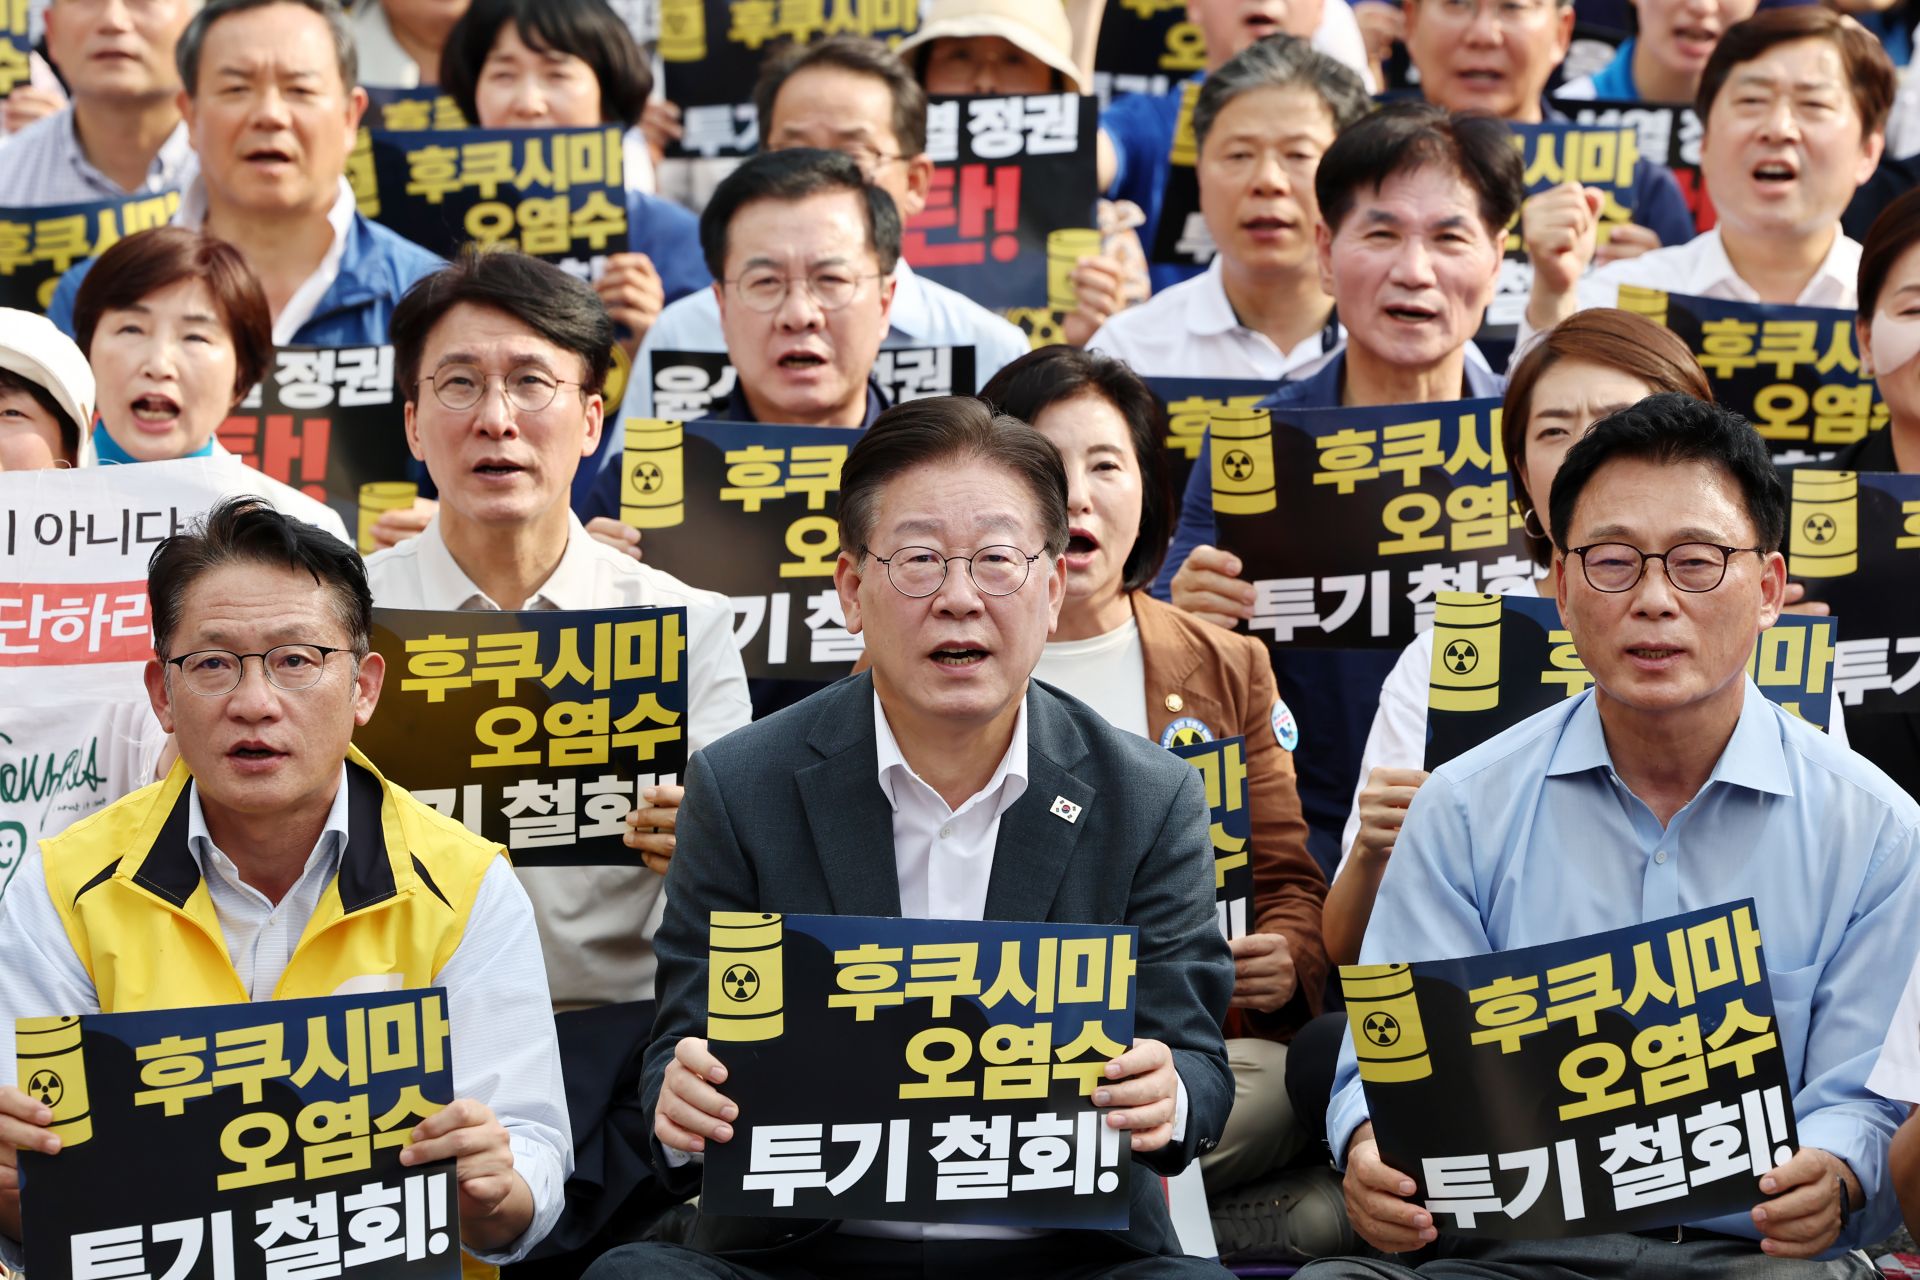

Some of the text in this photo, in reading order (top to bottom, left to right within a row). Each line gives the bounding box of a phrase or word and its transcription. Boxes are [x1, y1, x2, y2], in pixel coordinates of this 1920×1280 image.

[967, 92, 1080, 159] 정권
[1512, 128, 1640, 187] 시마
[405, 128, 624, 205] 후쿠시마
[463, 191, 628, 256] 오염수
[902, 164, 1022, 267] 탄!
[274, 345, 395, 409] 정권
[1696, 318, 1875, 380] 후쿠시
[1313, 408, 1508, 494] 후쿠시
[1752, 383, 1891, 444] 오염
[720, 444, 847, 511] 후쿠
[34, 507, 186, 556] 아니다
[1378, 481, 1523, 556] 오염
[732, 592, 790, 664] 기
[1248, 570, 1391, 642] 투기
[401, 614, 686, 703] 후쿠시마
[470, 693, 682, 768] 오염수
[408, 770, 683, 850] 기 철회
[828, 934, 1136, 1022] 후쿠시마
[1469, 906, 1761, 1054] 후쿠시마
[134, 995, 449, 1116] 후쿠시마
[899, 1020, 1127, 1101] 오염수
[1558, 999, 1777, 1121] 오염수
[217, 1085, 447, 1191] 오염수
[743, 1111, 1120, 1207] 투기 철회!
[1422, 1085, 1793, 1229] 투기 철회!
[71, 1172, 449, 1280] 투기 철회!
